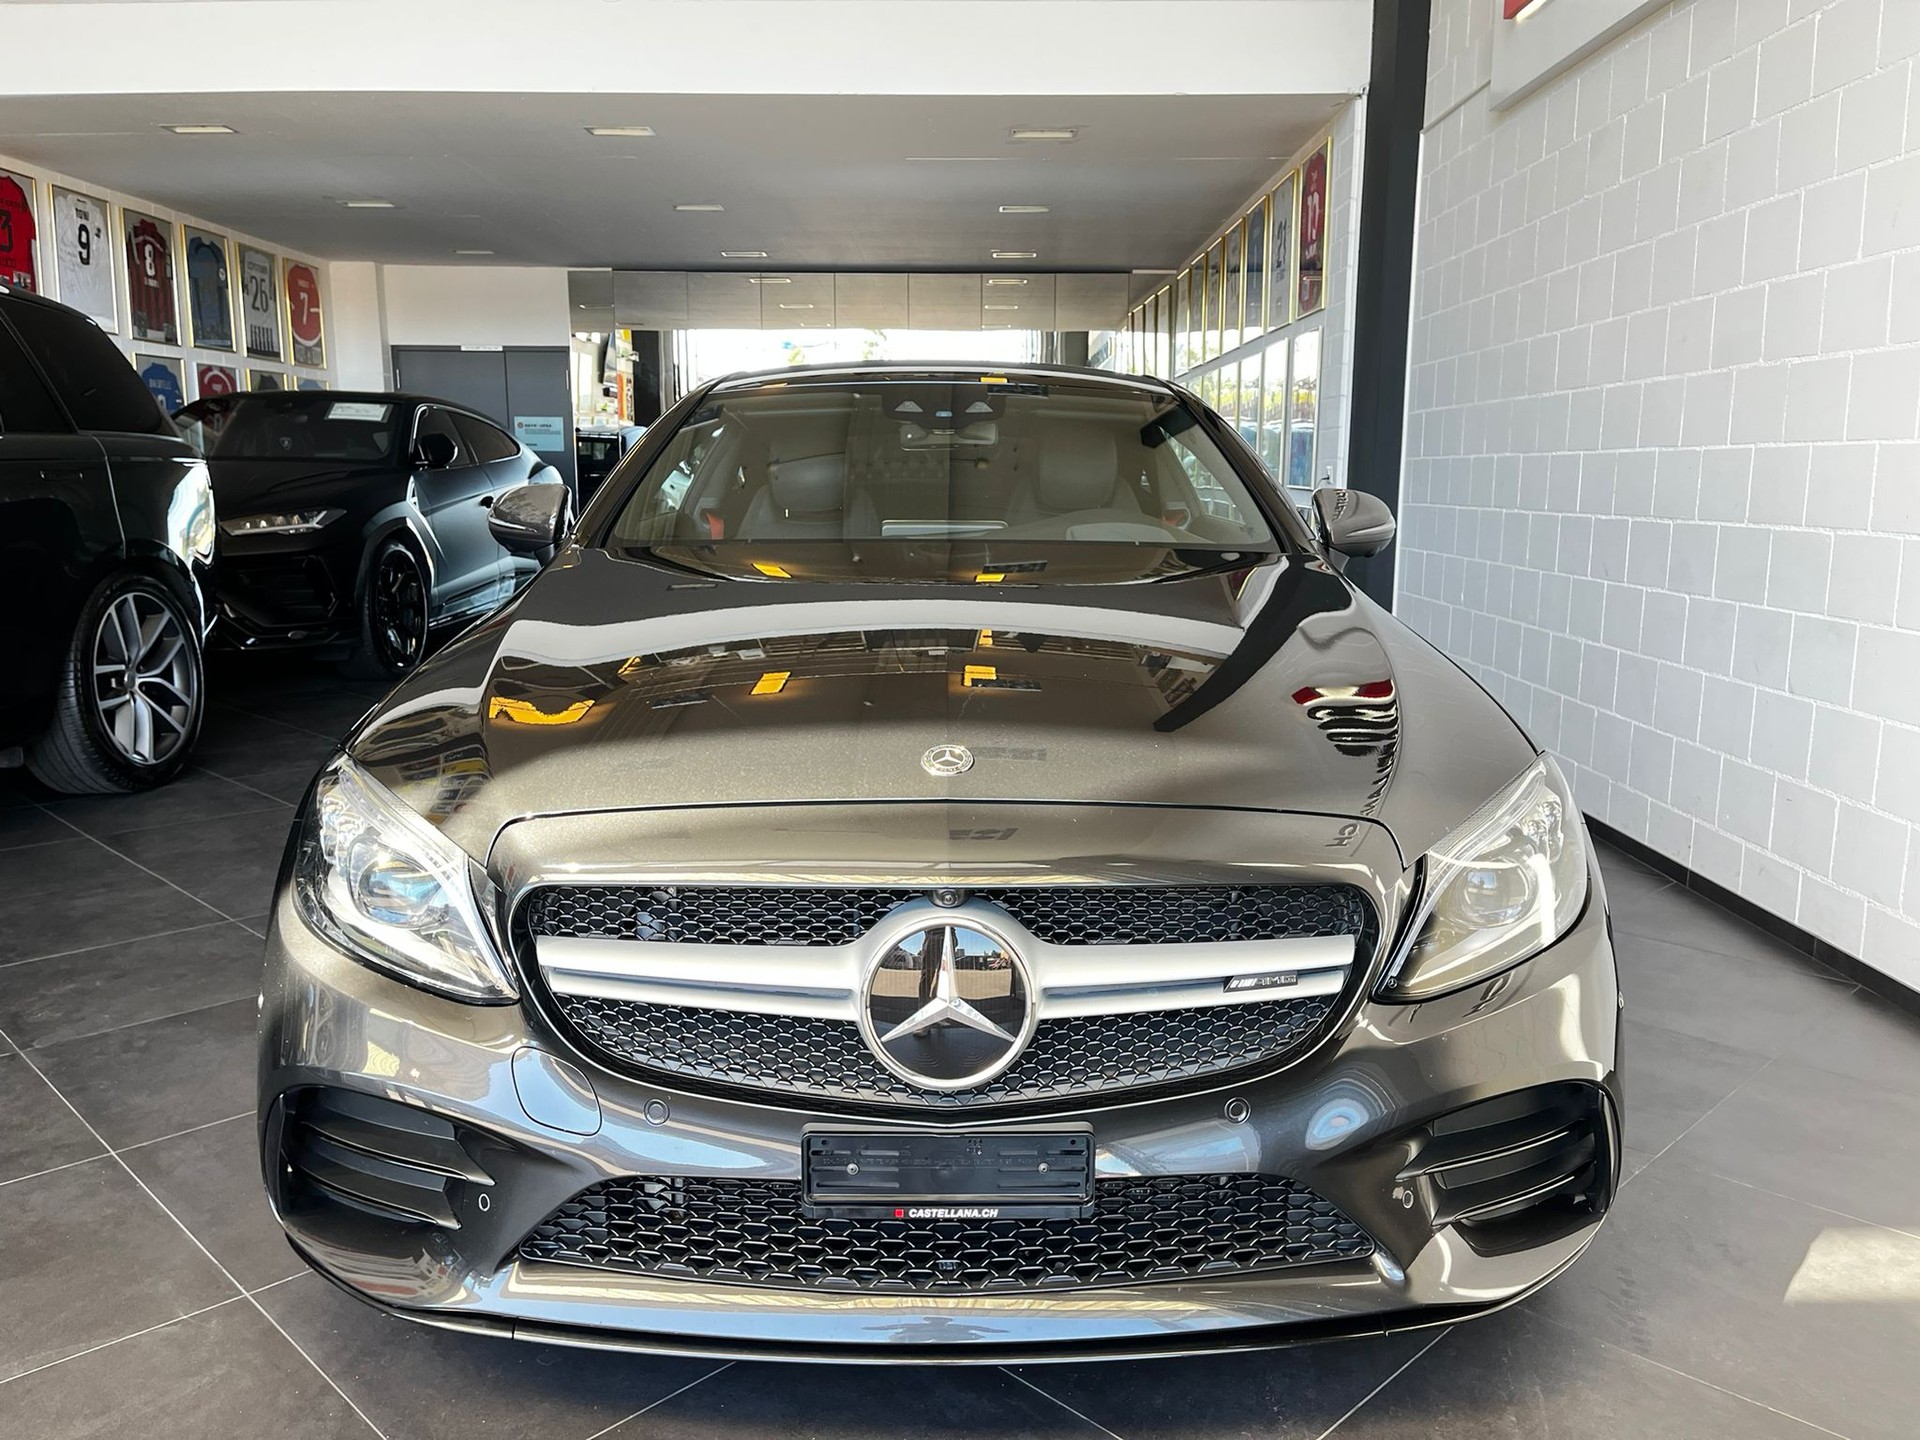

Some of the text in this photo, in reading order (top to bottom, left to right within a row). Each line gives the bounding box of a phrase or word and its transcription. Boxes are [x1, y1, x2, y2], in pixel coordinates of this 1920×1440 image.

[78, 223, 90, 266] 9
[144, 243, 156, 277] 8
[249, 275, 269, 313] 26
[299, 291, 309, 326] 7
[908, 1208, 999, 1218] CASTELLANA.CH
